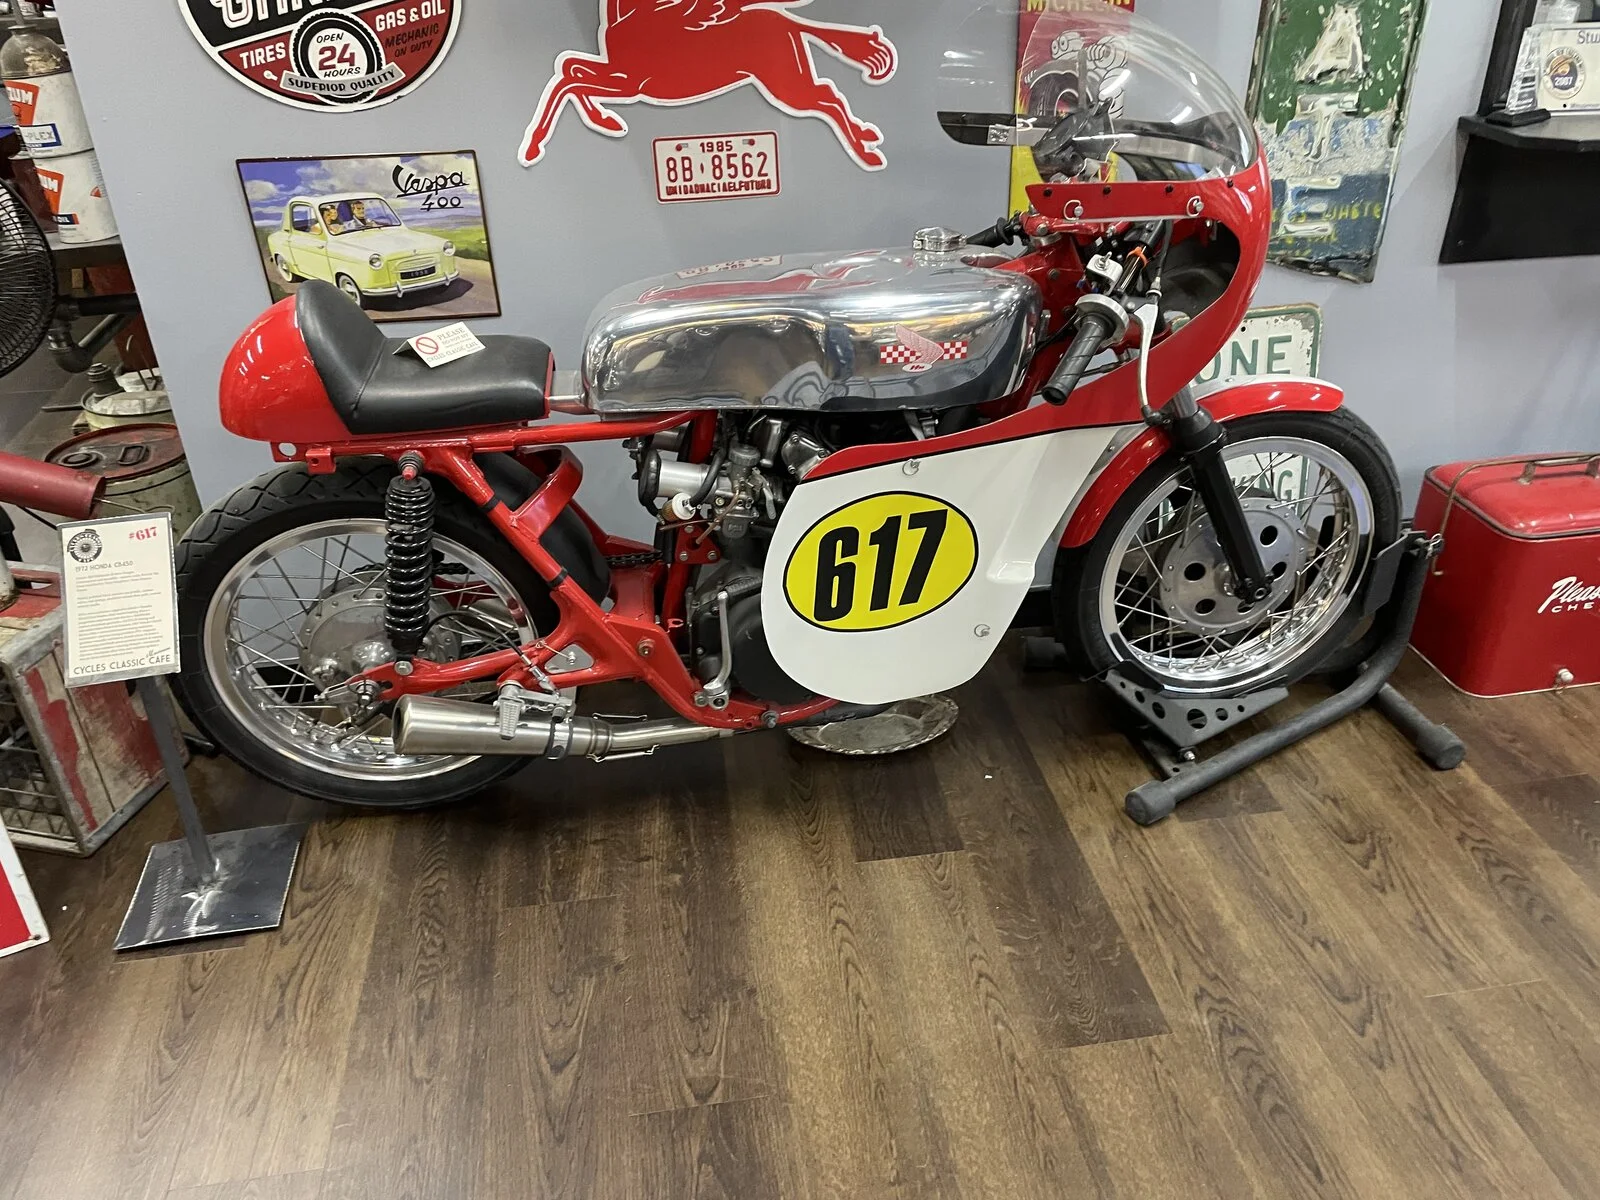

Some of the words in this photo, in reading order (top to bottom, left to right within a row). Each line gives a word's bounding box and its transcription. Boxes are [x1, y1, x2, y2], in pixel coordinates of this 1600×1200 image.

[375, 8, 407, 32] GAS
[409, 7, 420, 22] &
[421, 0, 447, 19] OIL
[316, 32, 344, 43] OPEN
[385, 23, 439, 48] MECHANIC
[239, 42, 286, 70] TIRES
[318, 43, 356, 70] 24
[394, 47, 407, 57] ON
[411, 40, 433, 53] DUTY
[287, 76, 346, 92] SUPERIOR
[350, 69, 395, 91] QUALITY
[324, 66, 361, 78] HOURS
[699, 141, 733, 153] 1985
[711, 151, 769, 181] 8562
[392, 165, 468, 197] Vespa
[421, 194, 462, 211] 400
[129, 526, 158, 541] #617
[814, 508, 948, 622] 617
[73, 661, 106, 675] CYCLES
[109, 657, 145, 670] CLASSIC
[149, 654, 171, 664] CAFE
